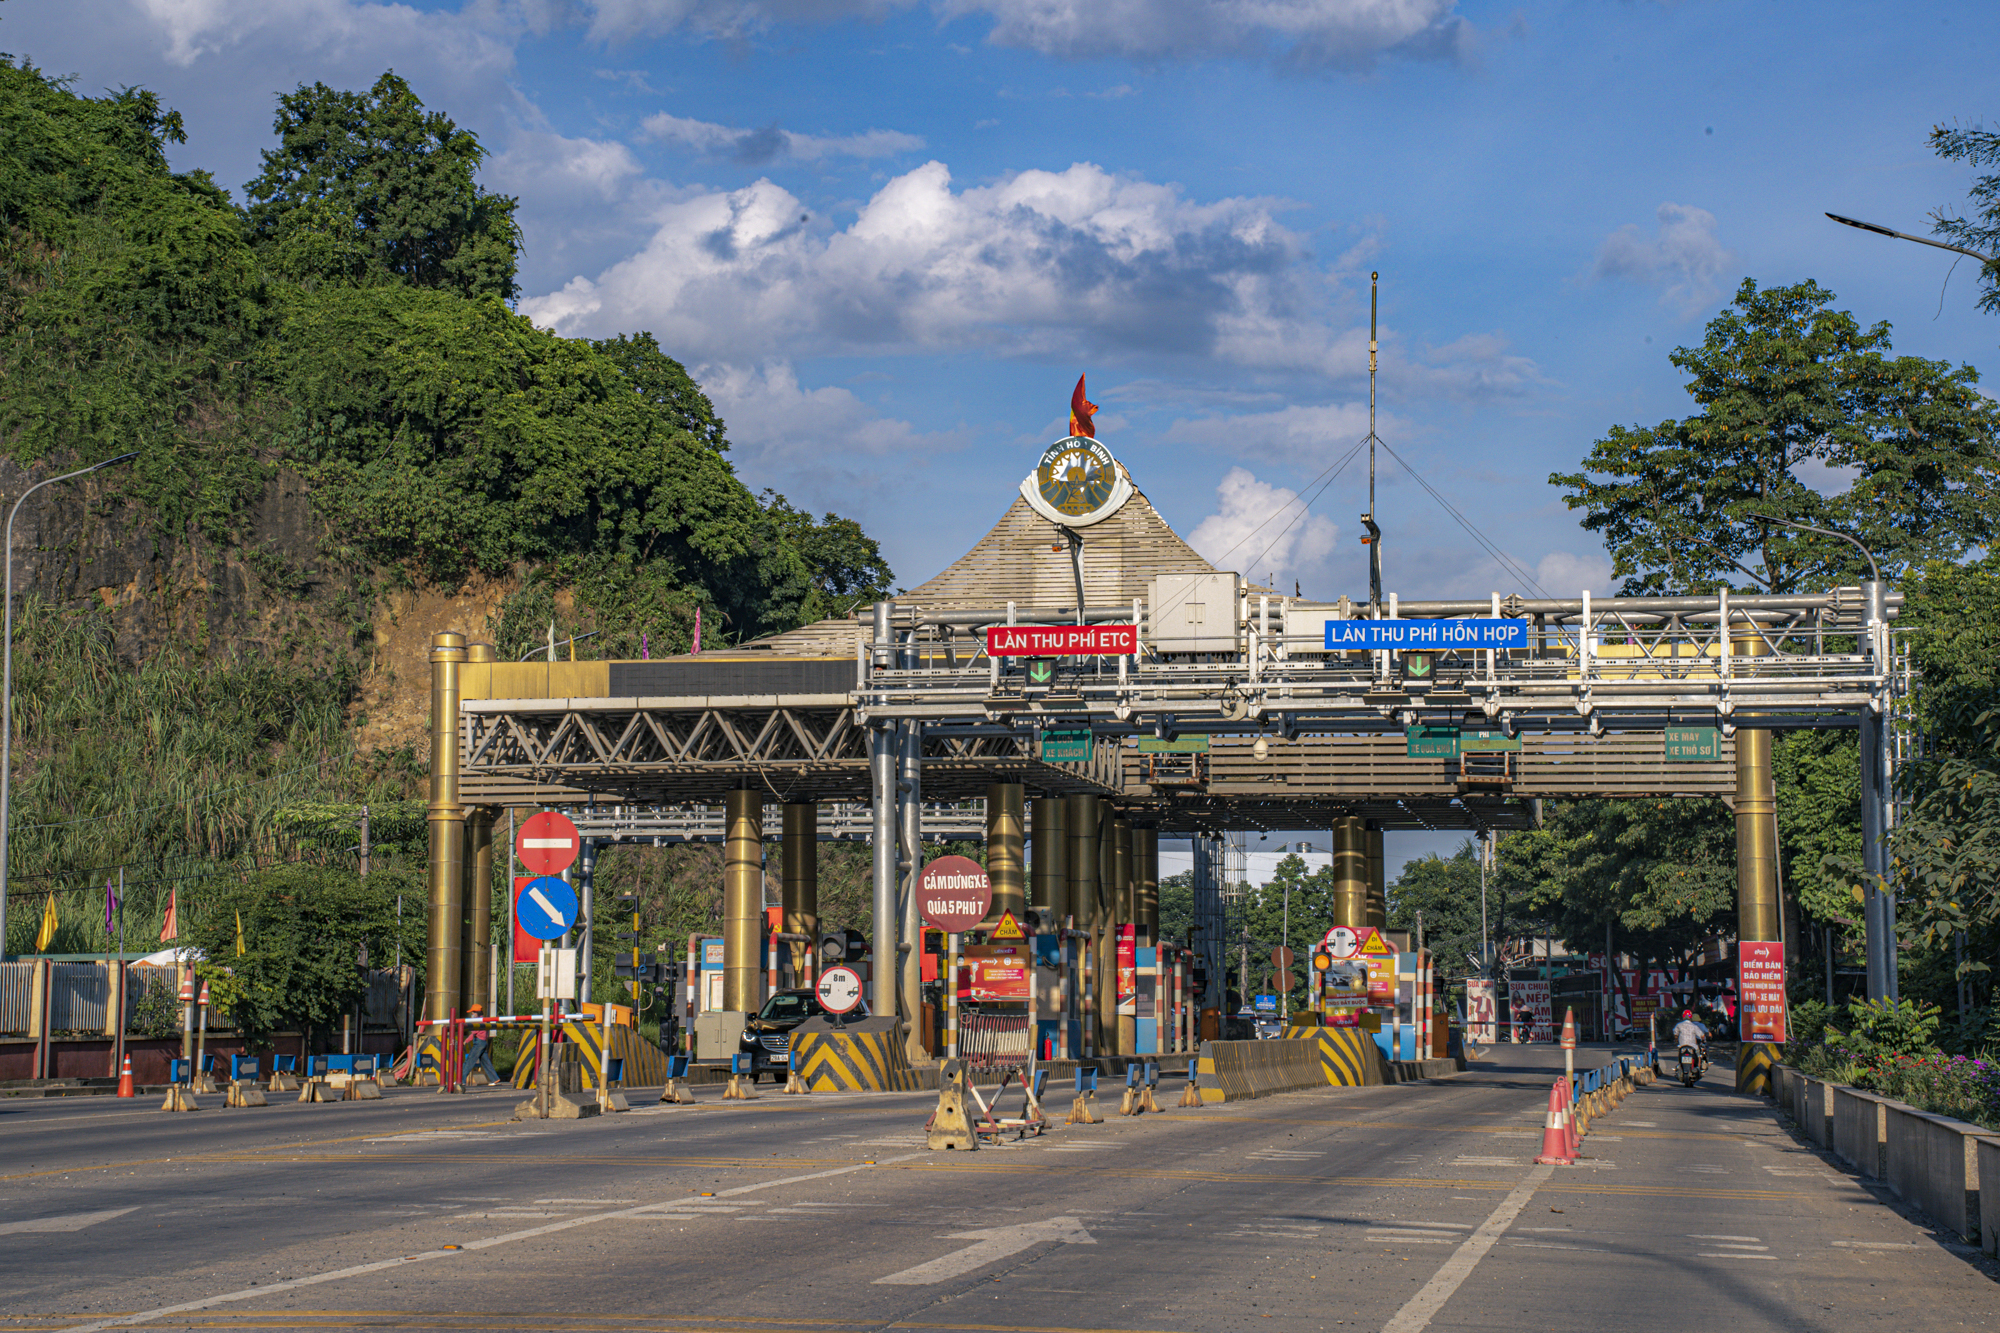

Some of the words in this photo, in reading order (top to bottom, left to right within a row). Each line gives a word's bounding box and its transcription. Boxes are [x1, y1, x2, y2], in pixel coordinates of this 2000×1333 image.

[1332, 622, 1366, 642] LÀN
[1371, 627, 1404, 642] THU
[1410, 622, 1437, 642] PHÍ
[1443, 620, 1478, 641] HỖN
[1484, 624, 1519, 646] HỢP
[994, 630, 1027, 648] LÀN
[1032, 634, 1064, 648] THU
[1068, 630, 1095, 647] PHÍ
[1100, 632, 1130, 646] ETC
[1669, 732, 1679, 741] XE
[1046, 749, 1055, 757] XE
[1058, 747, 1083, 757] KHÁCH
[1411, 744, 1420, 753] XE
[1669, 746, 1679, 755] XE
[948, 900, 955, 914] 5
[956, 897, 984, 915] PHÚT
[1743, 959, 1762, 968] ĐIỂM
[1765, 961, 1781, 969] BÁN
[834, 974, 845, 982] 8m
[1744, 971, 1759, 979] BẢO
[1762, 971, 1780, 980] HIỂM
[1760, 993, 1767, 1001] XE
[1768, 992, 1780, 1001] MÁY
[1744, 1004, 1756, 1012] GIÁ
